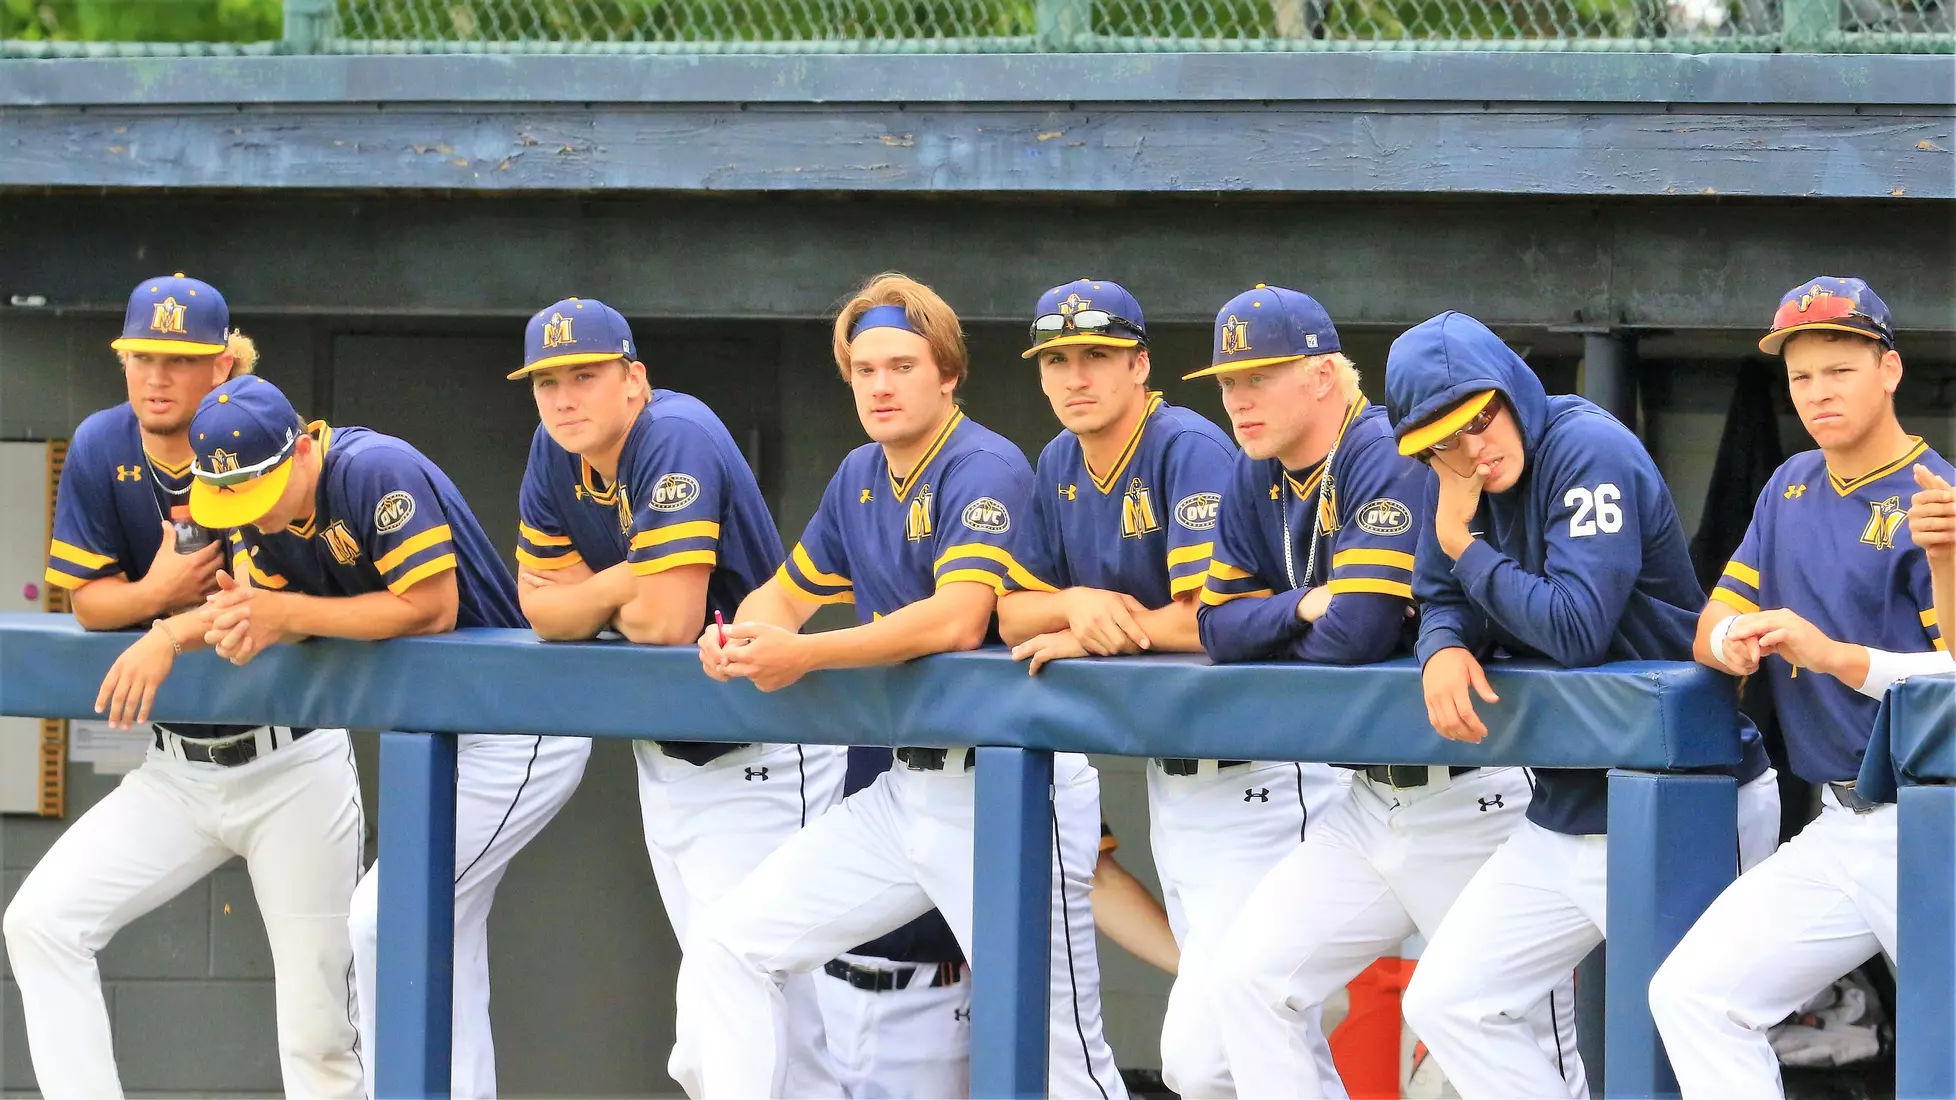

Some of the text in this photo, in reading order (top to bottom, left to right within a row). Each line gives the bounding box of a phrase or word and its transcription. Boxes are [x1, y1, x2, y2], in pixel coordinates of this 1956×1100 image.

[656, 482, 687, 502] OVC
[380, 499, 405, 526] OVC
[970, 507, 1002, 525] OVC
[1121, 484, 1161, 540] M
[1367, 510, 1401, 526] OVC
[1564, 483, 1624, 538] 26
